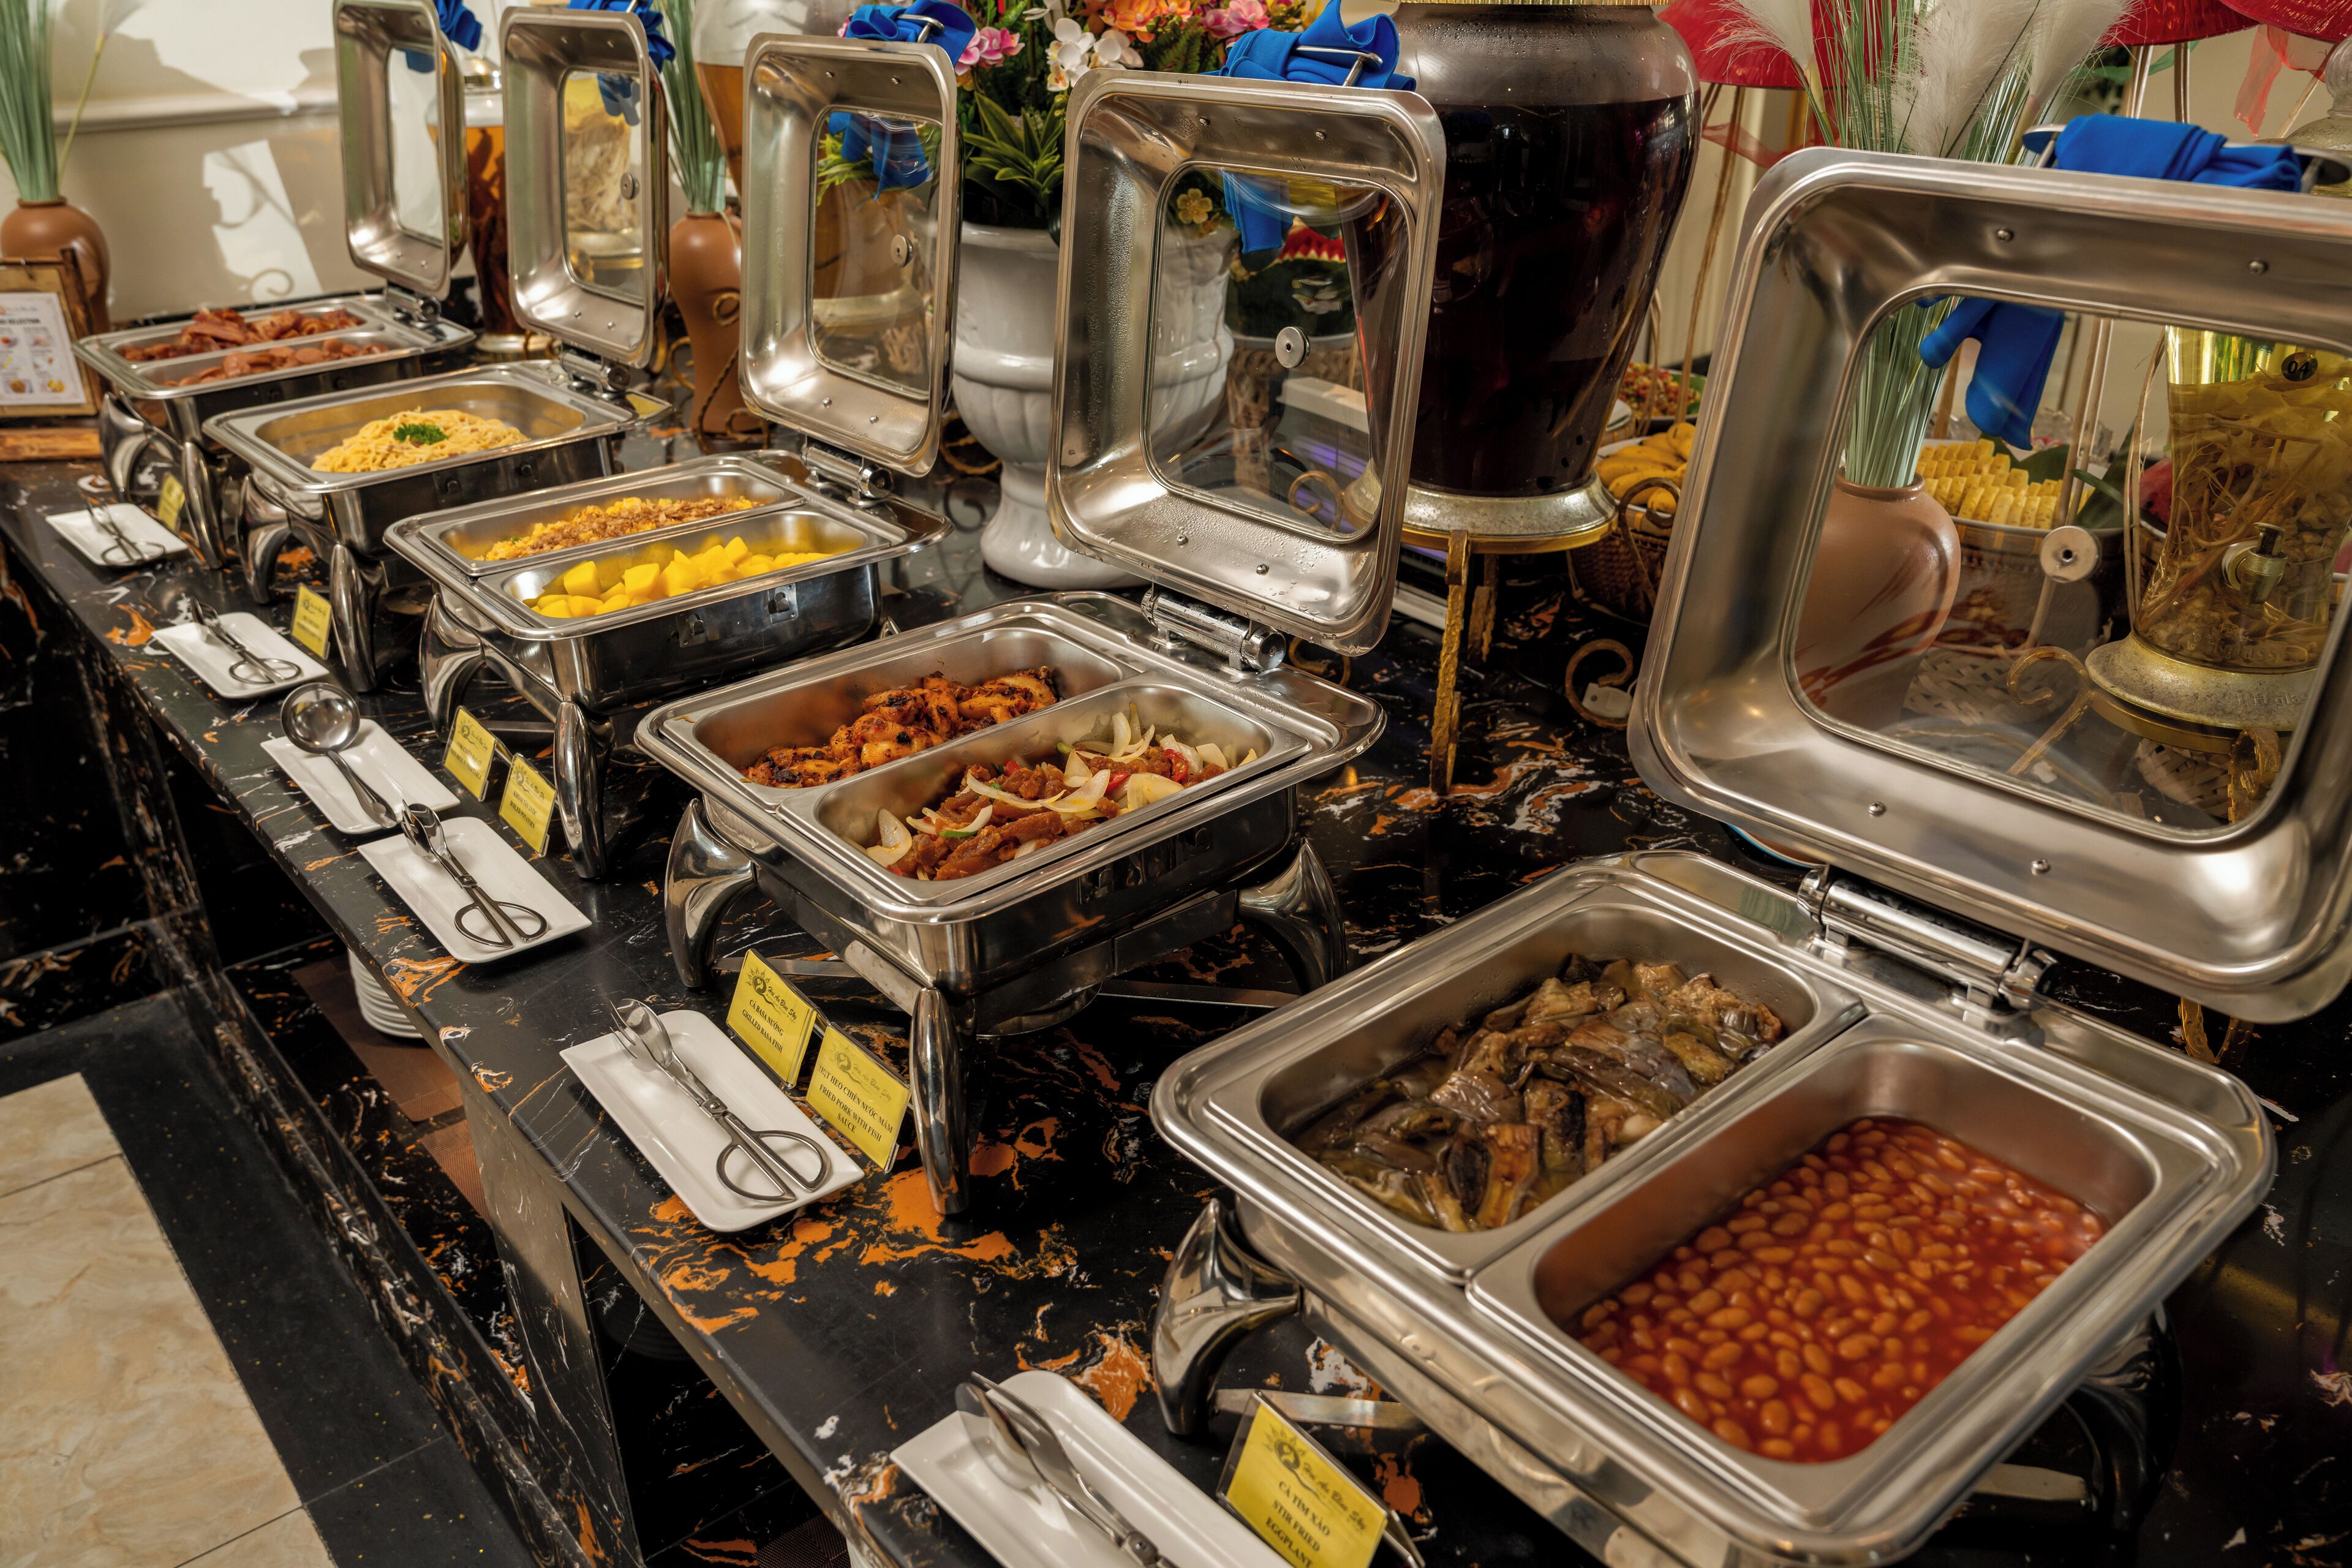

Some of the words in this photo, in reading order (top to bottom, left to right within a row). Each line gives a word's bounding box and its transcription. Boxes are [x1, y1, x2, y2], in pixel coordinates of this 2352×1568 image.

[2288, 360, 2309, 374] 04
[749, 999, 757, 1009] CÁ
[755, 1004, 767, 1021] BASA
[780, 999, 789, 1011] Blue
[788, 1008, 798, 1021] Sky
[742, 1009, 761, 1031] GRILLED
[760, 1028, 772, 1044] BASA
[771, 1039, 784, 1054] FISH
[830, 1076, 843, 1090] HEO
[870, 1078, 881, 1092] Blue
[880, 1088, 892, 1102] Sky
[819, 1084, 836, 1102] FRIED
[835, 1098, 853, 1117] PORK
[852, 1112, 869, 1131] WITH
[867, 1126, 883, 1142] FISH
[837, 1112, 857, 1134] SAUCE
[1278, 1480, 1292, 1498] CÀ
[1292, 1493, 1311, 1517] TÍM
[1310, 1512, 1331, 1537] XÀO
[1273, 1498, 1293, 1525] STIR
[1292, 1520, 1321, 1553] FRIED
[1265, 1516, 1314, 1568] EGGPLANT
